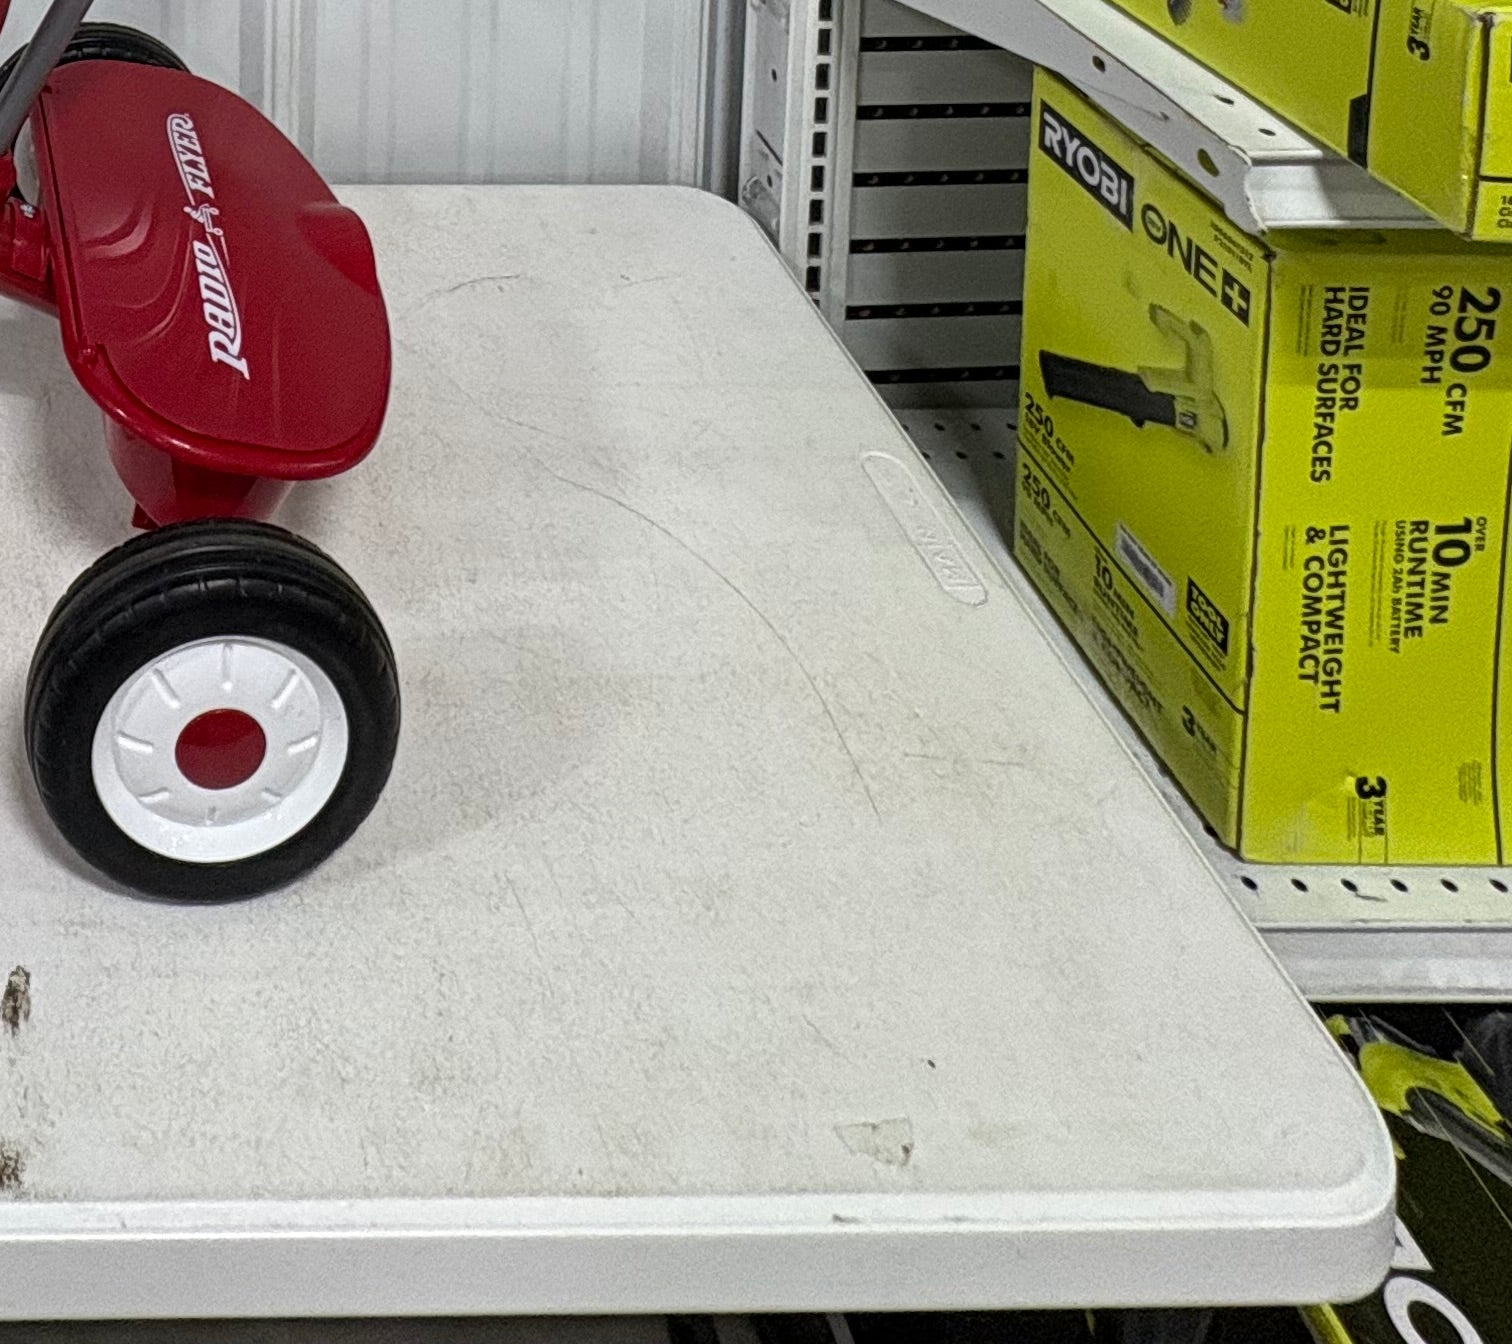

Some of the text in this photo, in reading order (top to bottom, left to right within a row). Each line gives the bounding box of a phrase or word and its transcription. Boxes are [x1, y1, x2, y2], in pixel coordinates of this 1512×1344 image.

[1407, 6, 1430, 61] 3 YEAR
[1044, 112, 1127, 215] RYOBI
[167, 112, 250, 380] RADIO FLYER
[1141, 203, 1251, 328] ONE+
[1310, 287, 1346, 483] HARD SURFACES
[1339, 286, 1370, 411] IDEAL FOR
[1421, 285, 1454, 384] 90 MPH
[1442, 286, 1502, 436] 250 CFM
[1025, 392, 1053, 438] 250
[1023, 463, 1050, 510] 250
[1475, 516, 1487, 552] OVER
[1095, 553, 1112, 591] 10
[1191, 585, 1224, 633] TOOL
[1191, 600, 1225, 644] ONLY
[1298, 526, 1326, 685] & COMPACT
[1319, 525, 1350, 714] LIGHTWEIGHT
[1389, 520, 1407, 654] USING 2Ah BATTERY
[1404, 520, 1429, 639] RUNTIME
[1428, 517, 1472, 624] 10 MIN
[1182, 705, 1196, 737] 3
[1355, 776, 1387, 836] 3 YEAR
